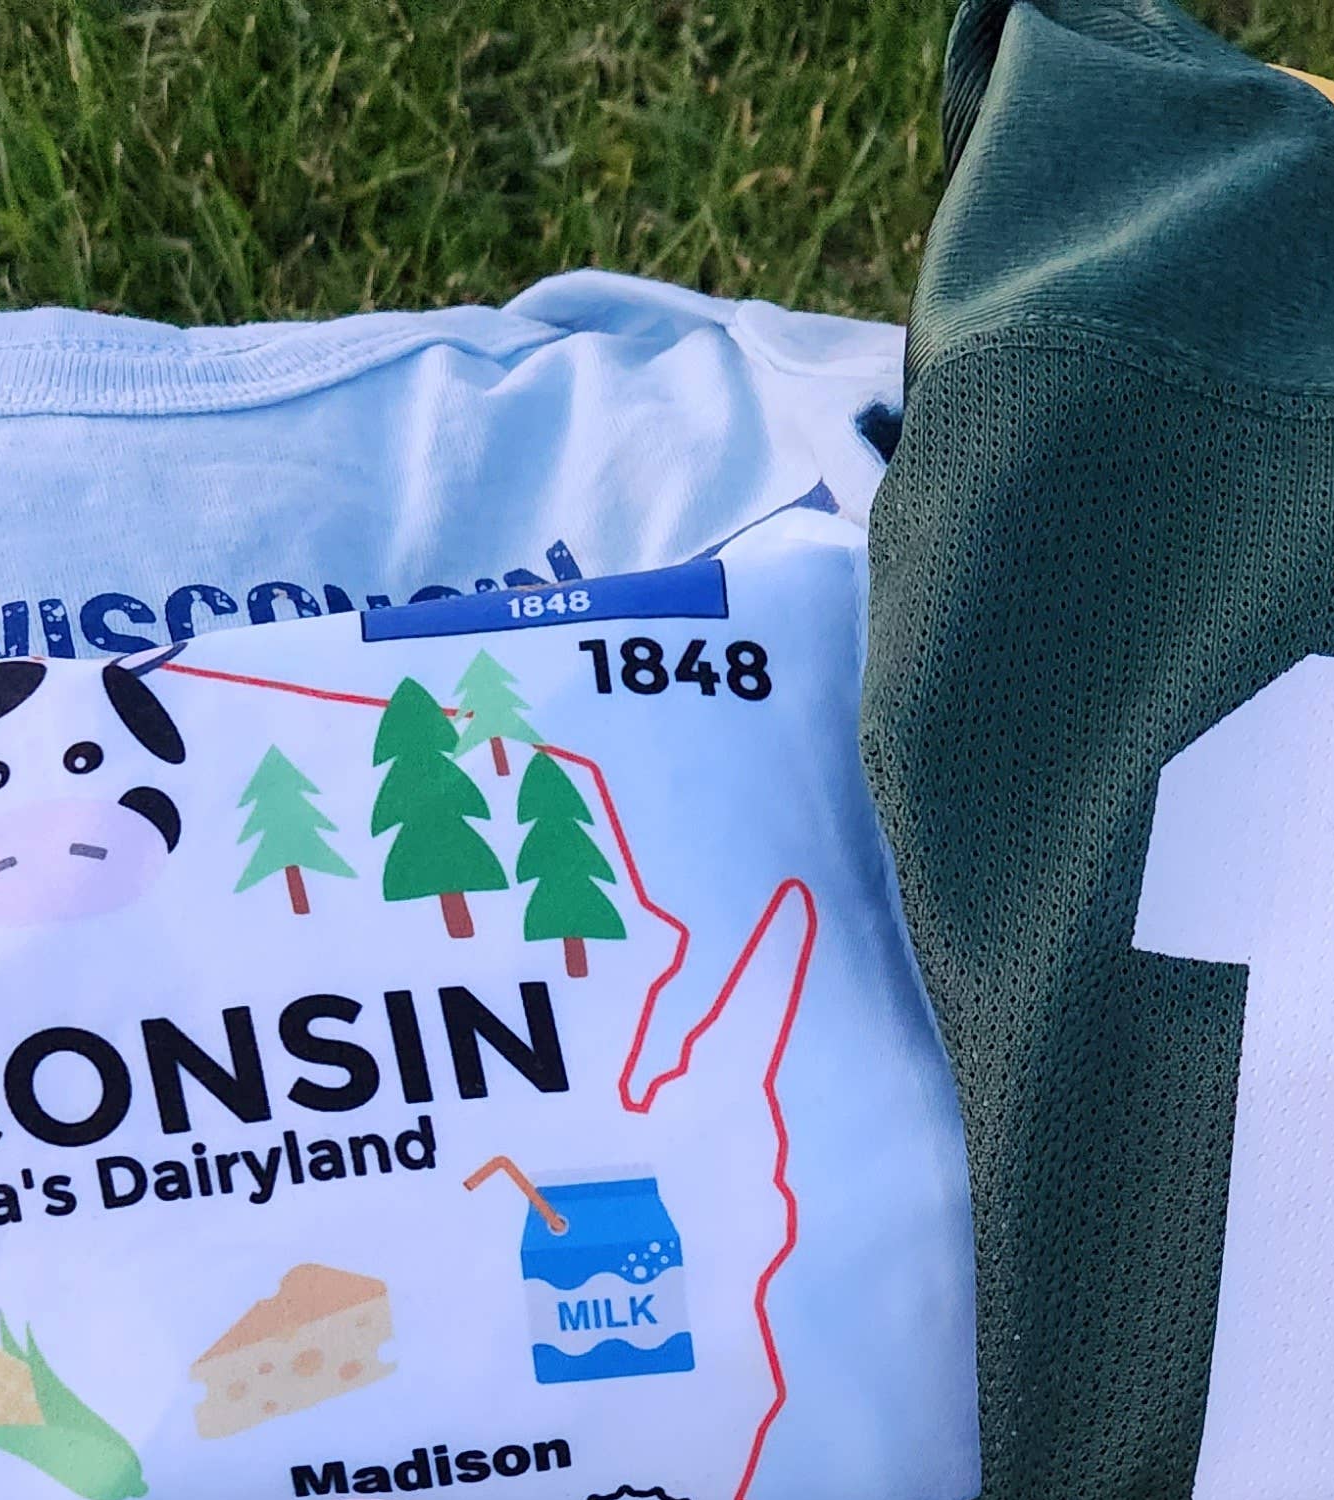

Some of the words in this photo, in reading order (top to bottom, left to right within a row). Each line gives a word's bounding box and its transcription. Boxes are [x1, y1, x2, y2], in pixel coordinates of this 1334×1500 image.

[505, 589, 592, 619] 1848
[578, 636, 773, 702] 1848
[97, 1114, 439, 1211] Dairyland
[557, 1293, 659, 1332] MILK
[290, 1437, 573, 1498] Madison
